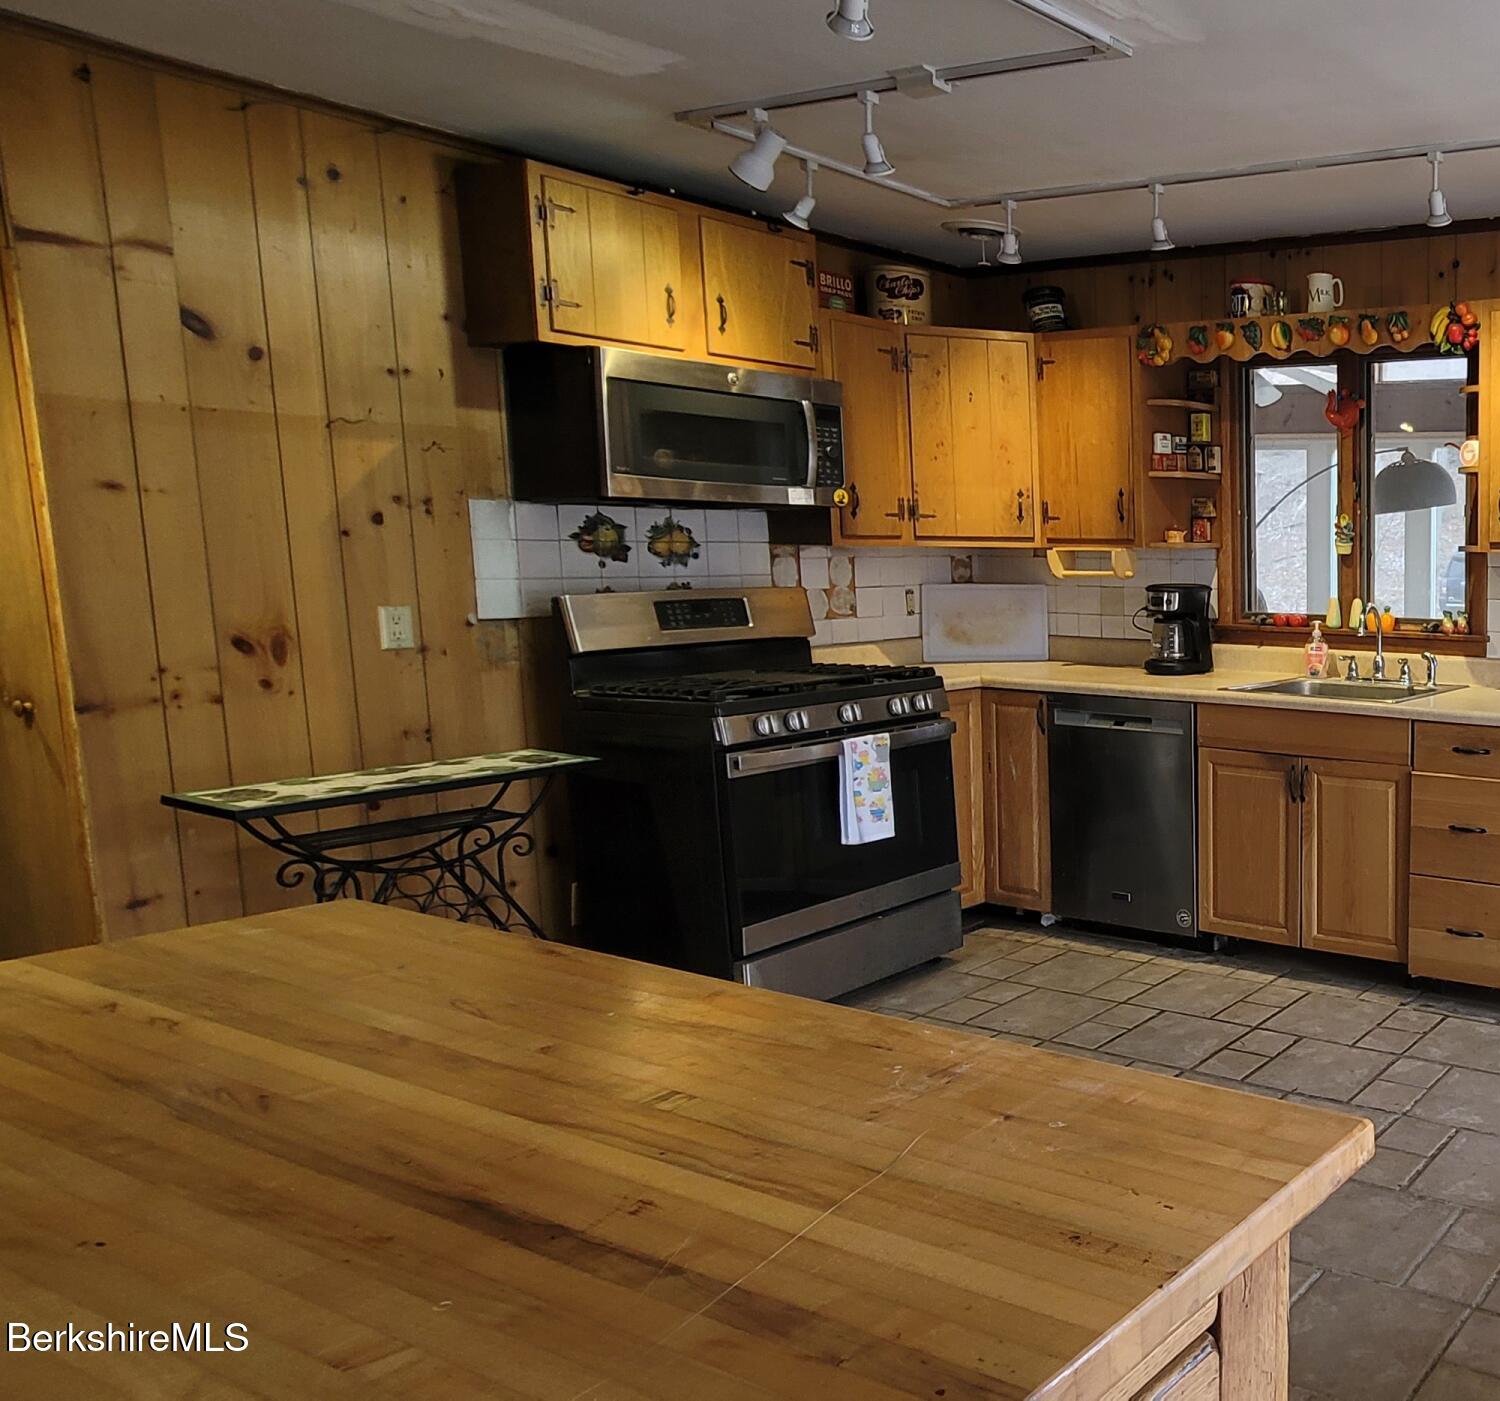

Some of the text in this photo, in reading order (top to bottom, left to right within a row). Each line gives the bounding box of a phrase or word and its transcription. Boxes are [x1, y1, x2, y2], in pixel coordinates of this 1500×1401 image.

[819, 273, 852, 292] BRILLO
[878, 275, 915, 290] Charles
[895, 282, 921, 298] Chips
